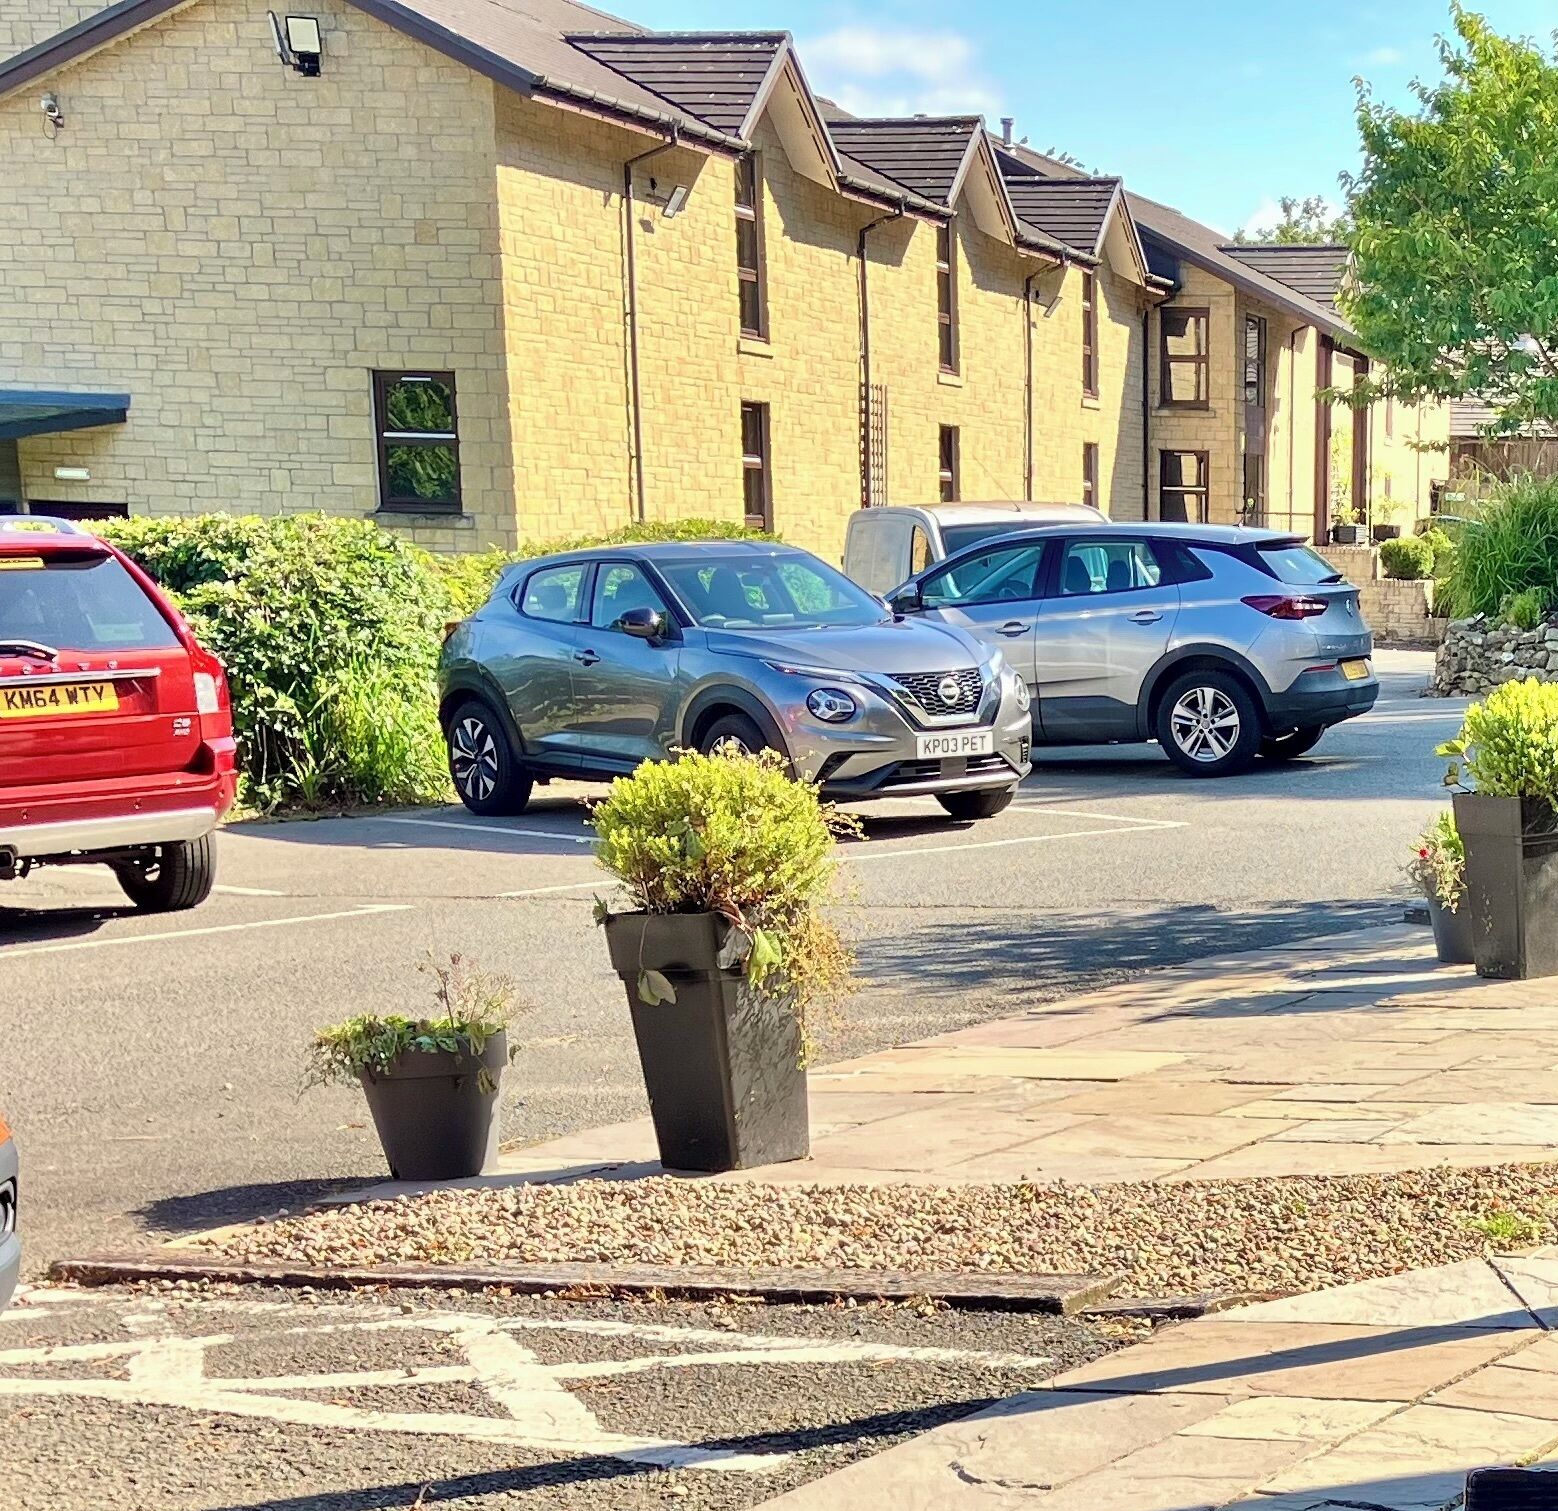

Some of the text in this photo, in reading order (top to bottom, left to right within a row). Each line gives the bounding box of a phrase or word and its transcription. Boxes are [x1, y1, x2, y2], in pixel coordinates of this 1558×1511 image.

[4, 685, 105, 710] KM64 WTY
[924, 735, 987, 754] KP03 PET
